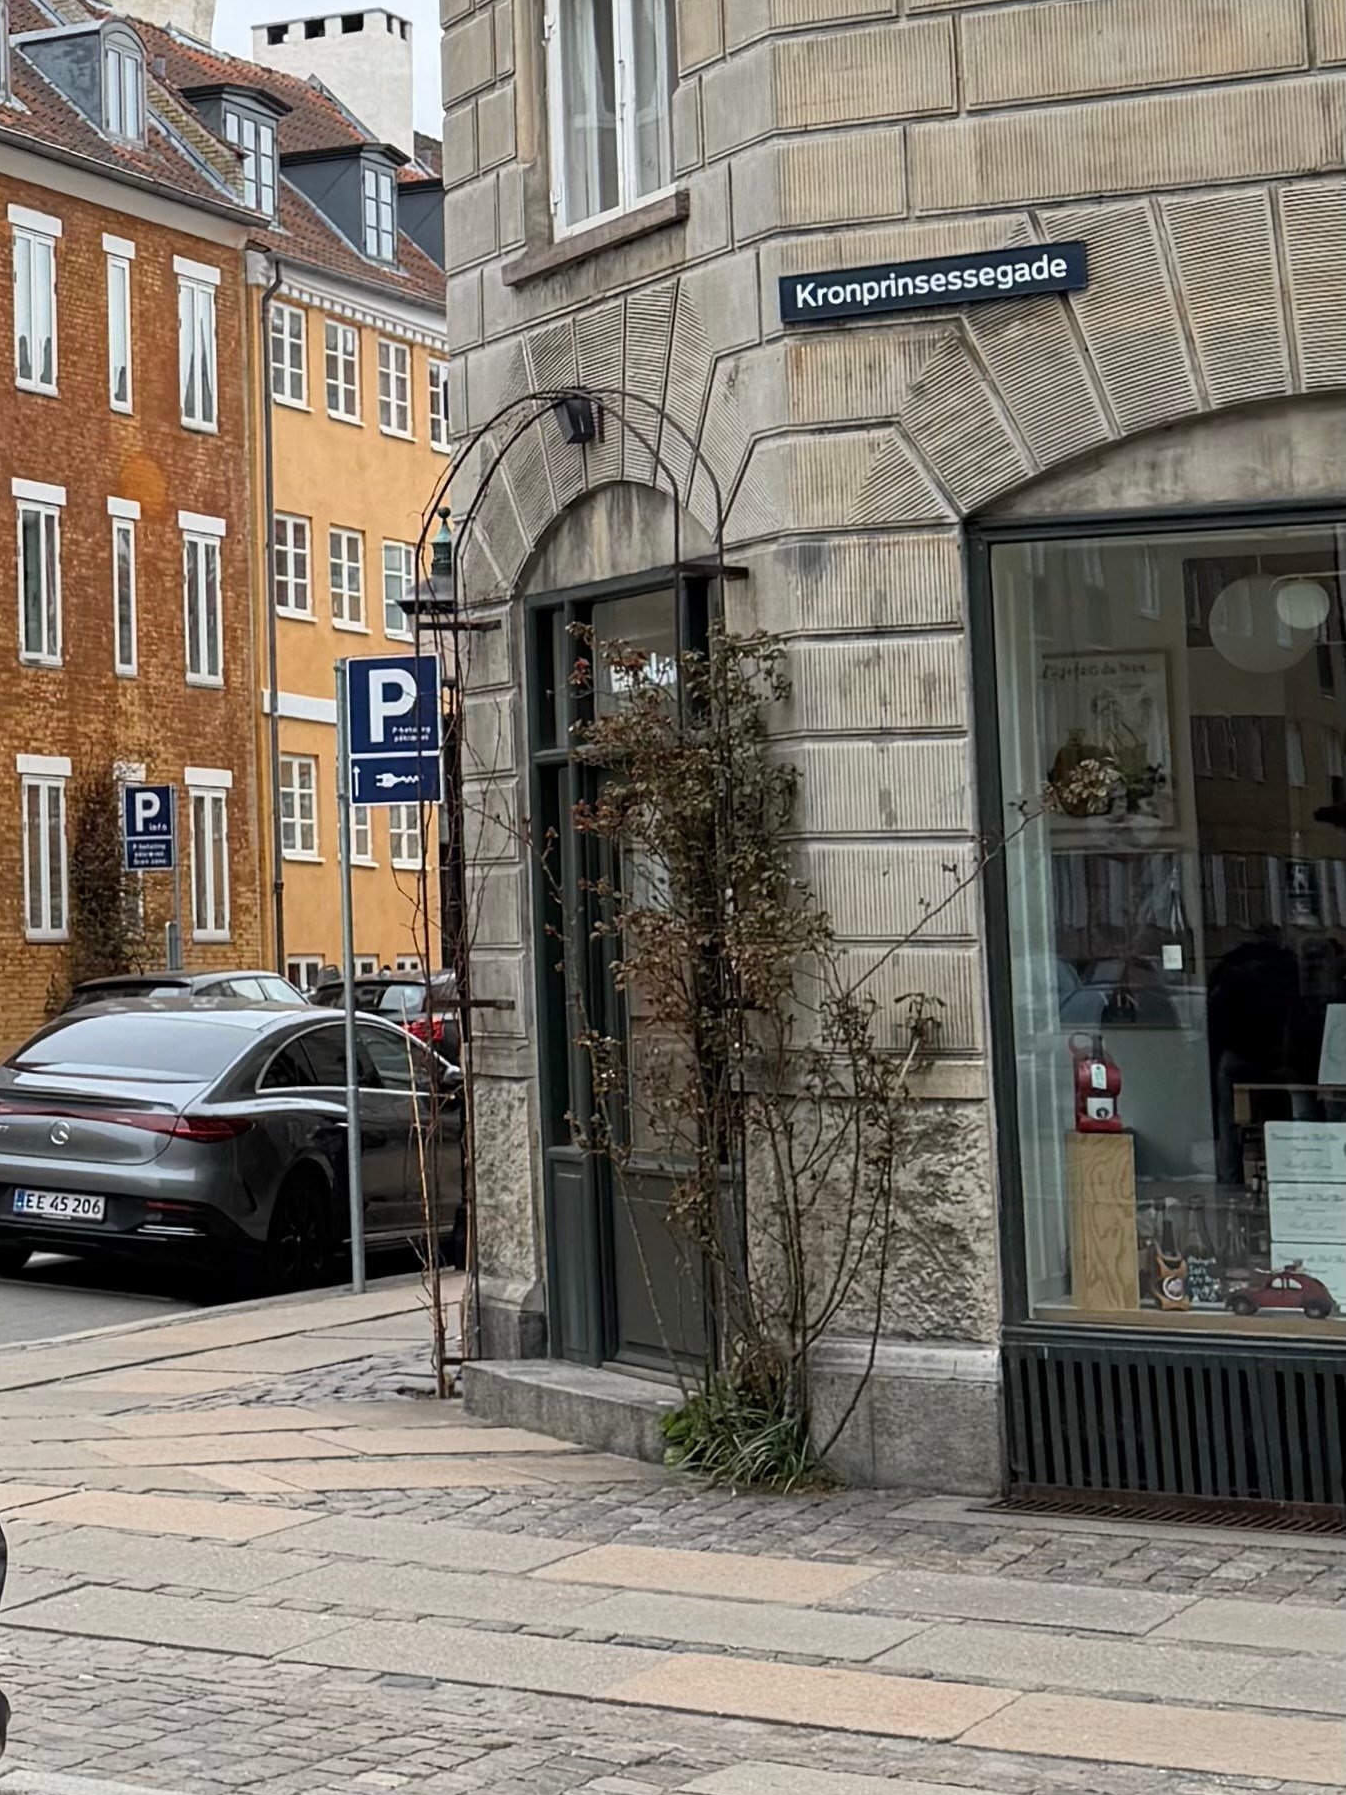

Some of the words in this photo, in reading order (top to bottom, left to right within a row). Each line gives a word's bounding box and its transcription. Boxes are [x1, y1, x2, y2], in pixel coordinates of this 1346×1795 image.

[796, 254, 1068, 308] Kronprinsessegade
[368, 668, 417, 743] P
[135, 792, 160, 832] P
[26, 1193, 45, 1210] EE
[49, 1195, 68, 1212] 45
[71, 1197, 101, 1215] 206
